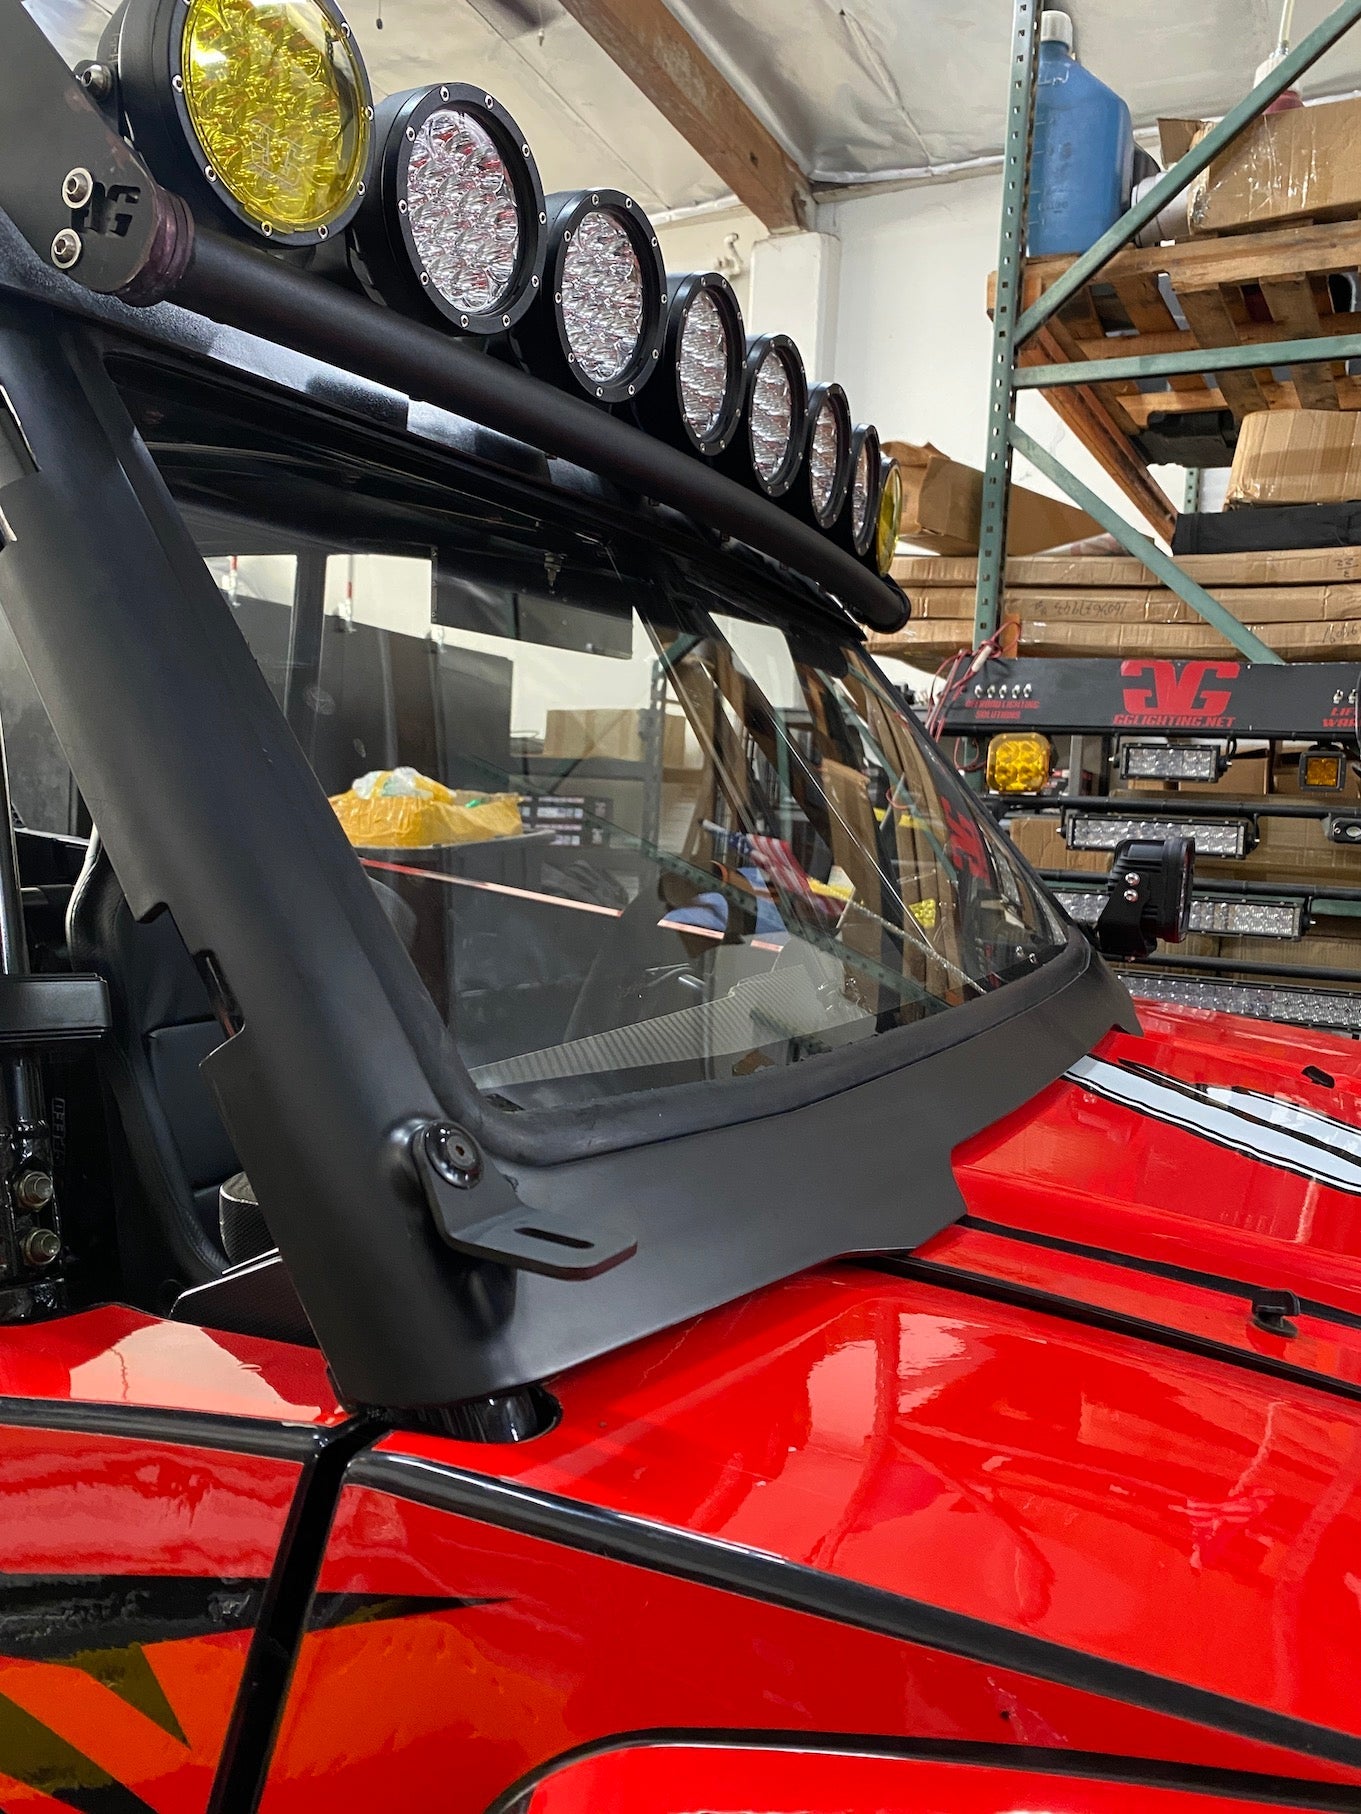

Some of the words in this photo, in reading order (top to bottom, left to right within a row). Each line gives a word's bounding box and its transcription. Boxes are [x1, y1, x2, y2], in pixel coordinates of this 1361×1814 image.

[1001, 700, 1040, 710] LIGHTING
[975, 710, 1021, 720] SOLUTIONS
[1113, 714, 1237, 728] GGLIGHTING.NET
